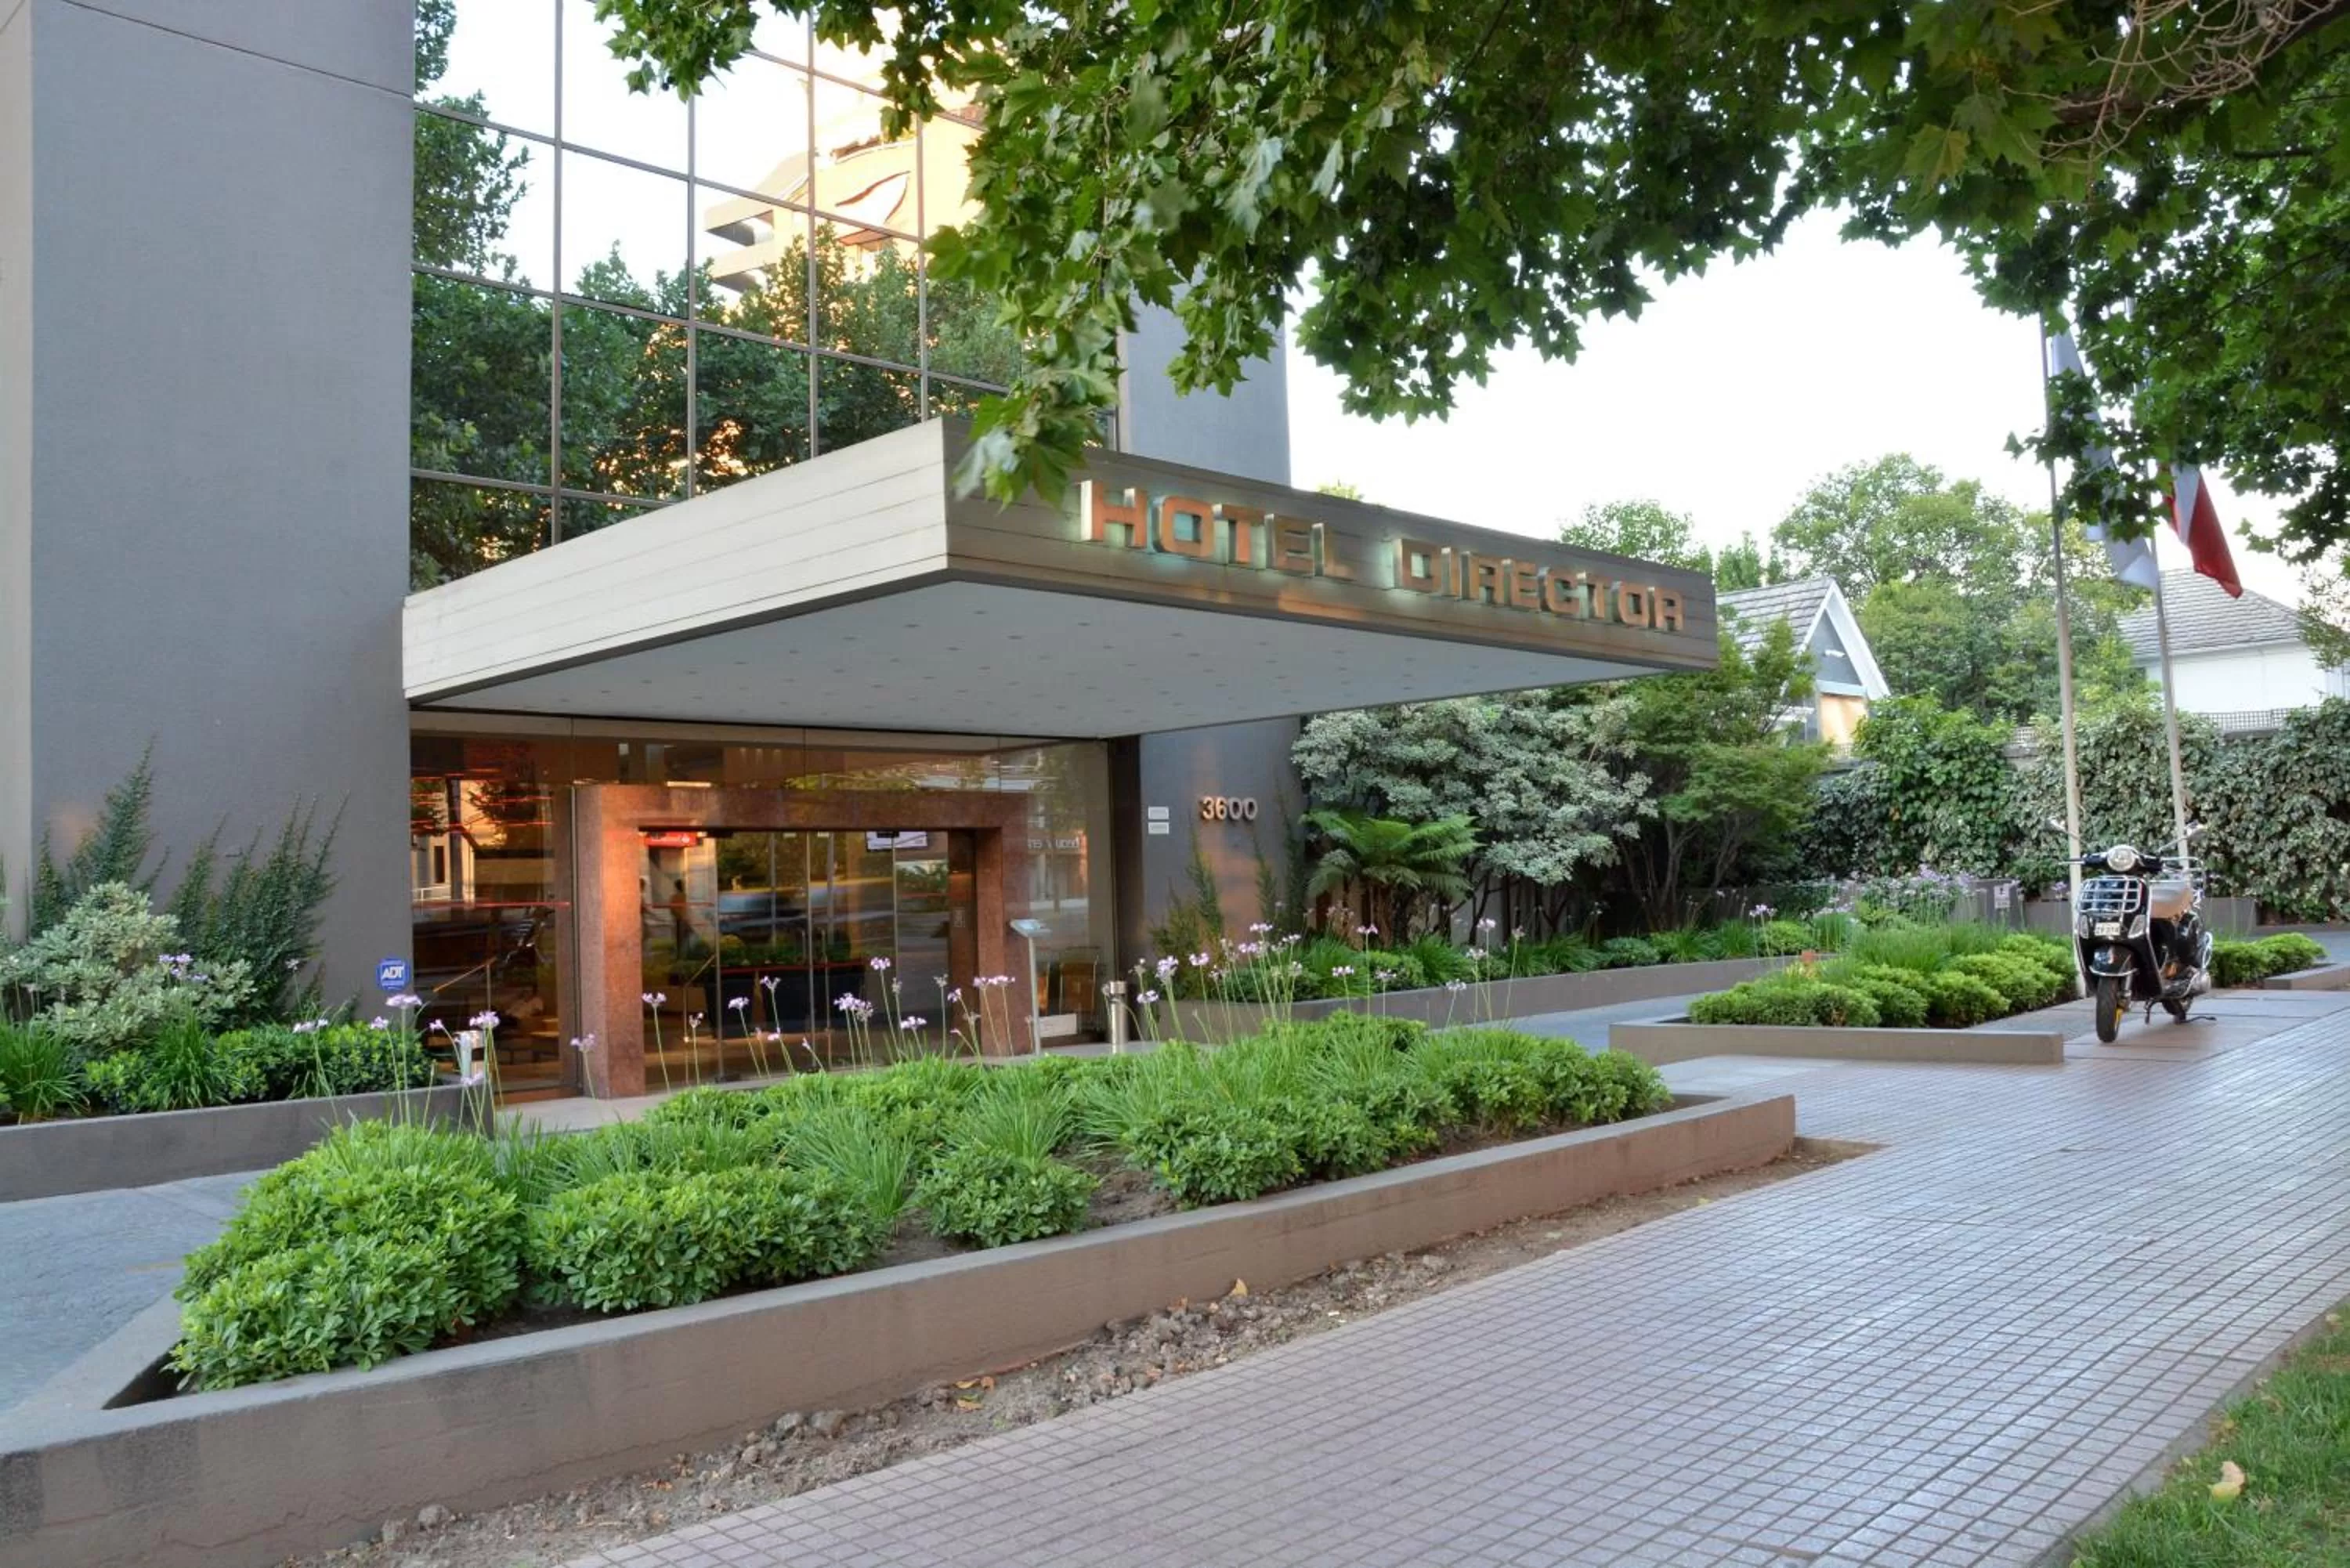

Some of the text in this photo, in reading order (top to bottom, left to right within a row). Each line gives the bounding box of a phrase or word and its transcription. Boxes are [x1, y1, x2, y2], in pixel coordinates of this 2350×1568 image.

[1080, 479, 1684, 630] HOTEL DIRECTOR
[1202, 796, 1257, 820] 3600
[381, 966, 404, 979] ADT
